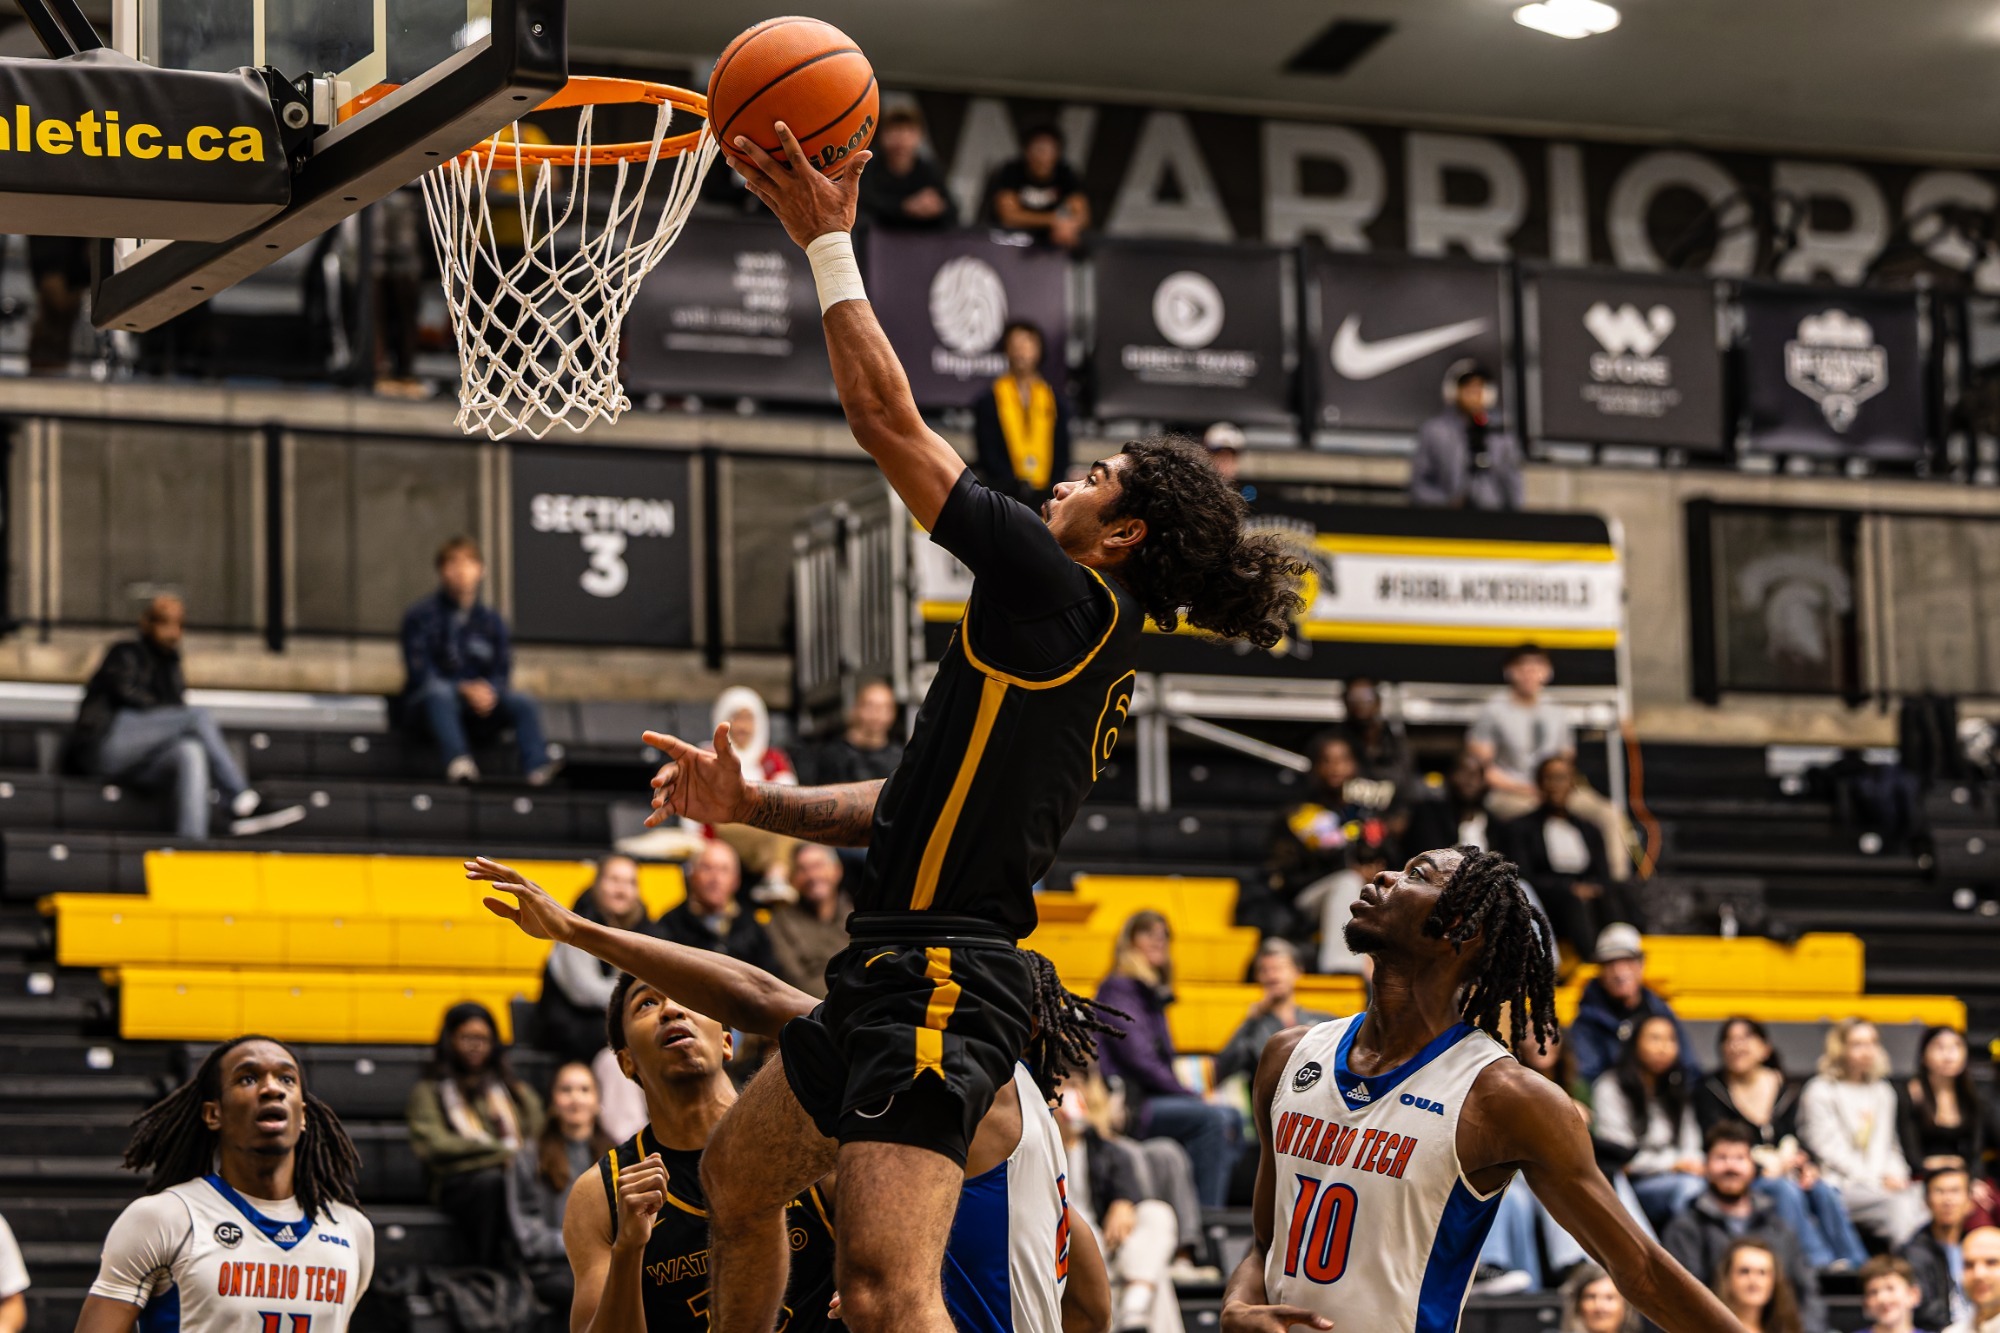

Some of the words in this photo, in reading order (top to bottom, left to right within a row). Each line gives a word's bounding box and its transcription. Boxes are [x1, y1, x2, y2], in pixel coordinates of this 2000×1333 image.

[0, 104, 265, 162] letic.ca
[784, 114, 875, 171] ilson
[530, 493, 675, 538] SECTION
[579, 531, 629, 598] 3
[1297, 1067, 1320, 1082] GF
[1347, 1091, 1371, 1102] adidas
[1399, 1093, 1444, 1116] OUA
[1275, 1111, 1359, 1167] ONTARIO
[1352, 1128, 1418, 1180] TECH
[217, 1225, 242, 1241] GF
[1284, 1173, 1358, 1285] 10
[218, 1261, 300, 1300] ONTARIO
[305, 1265, 347, 1304] TECH
